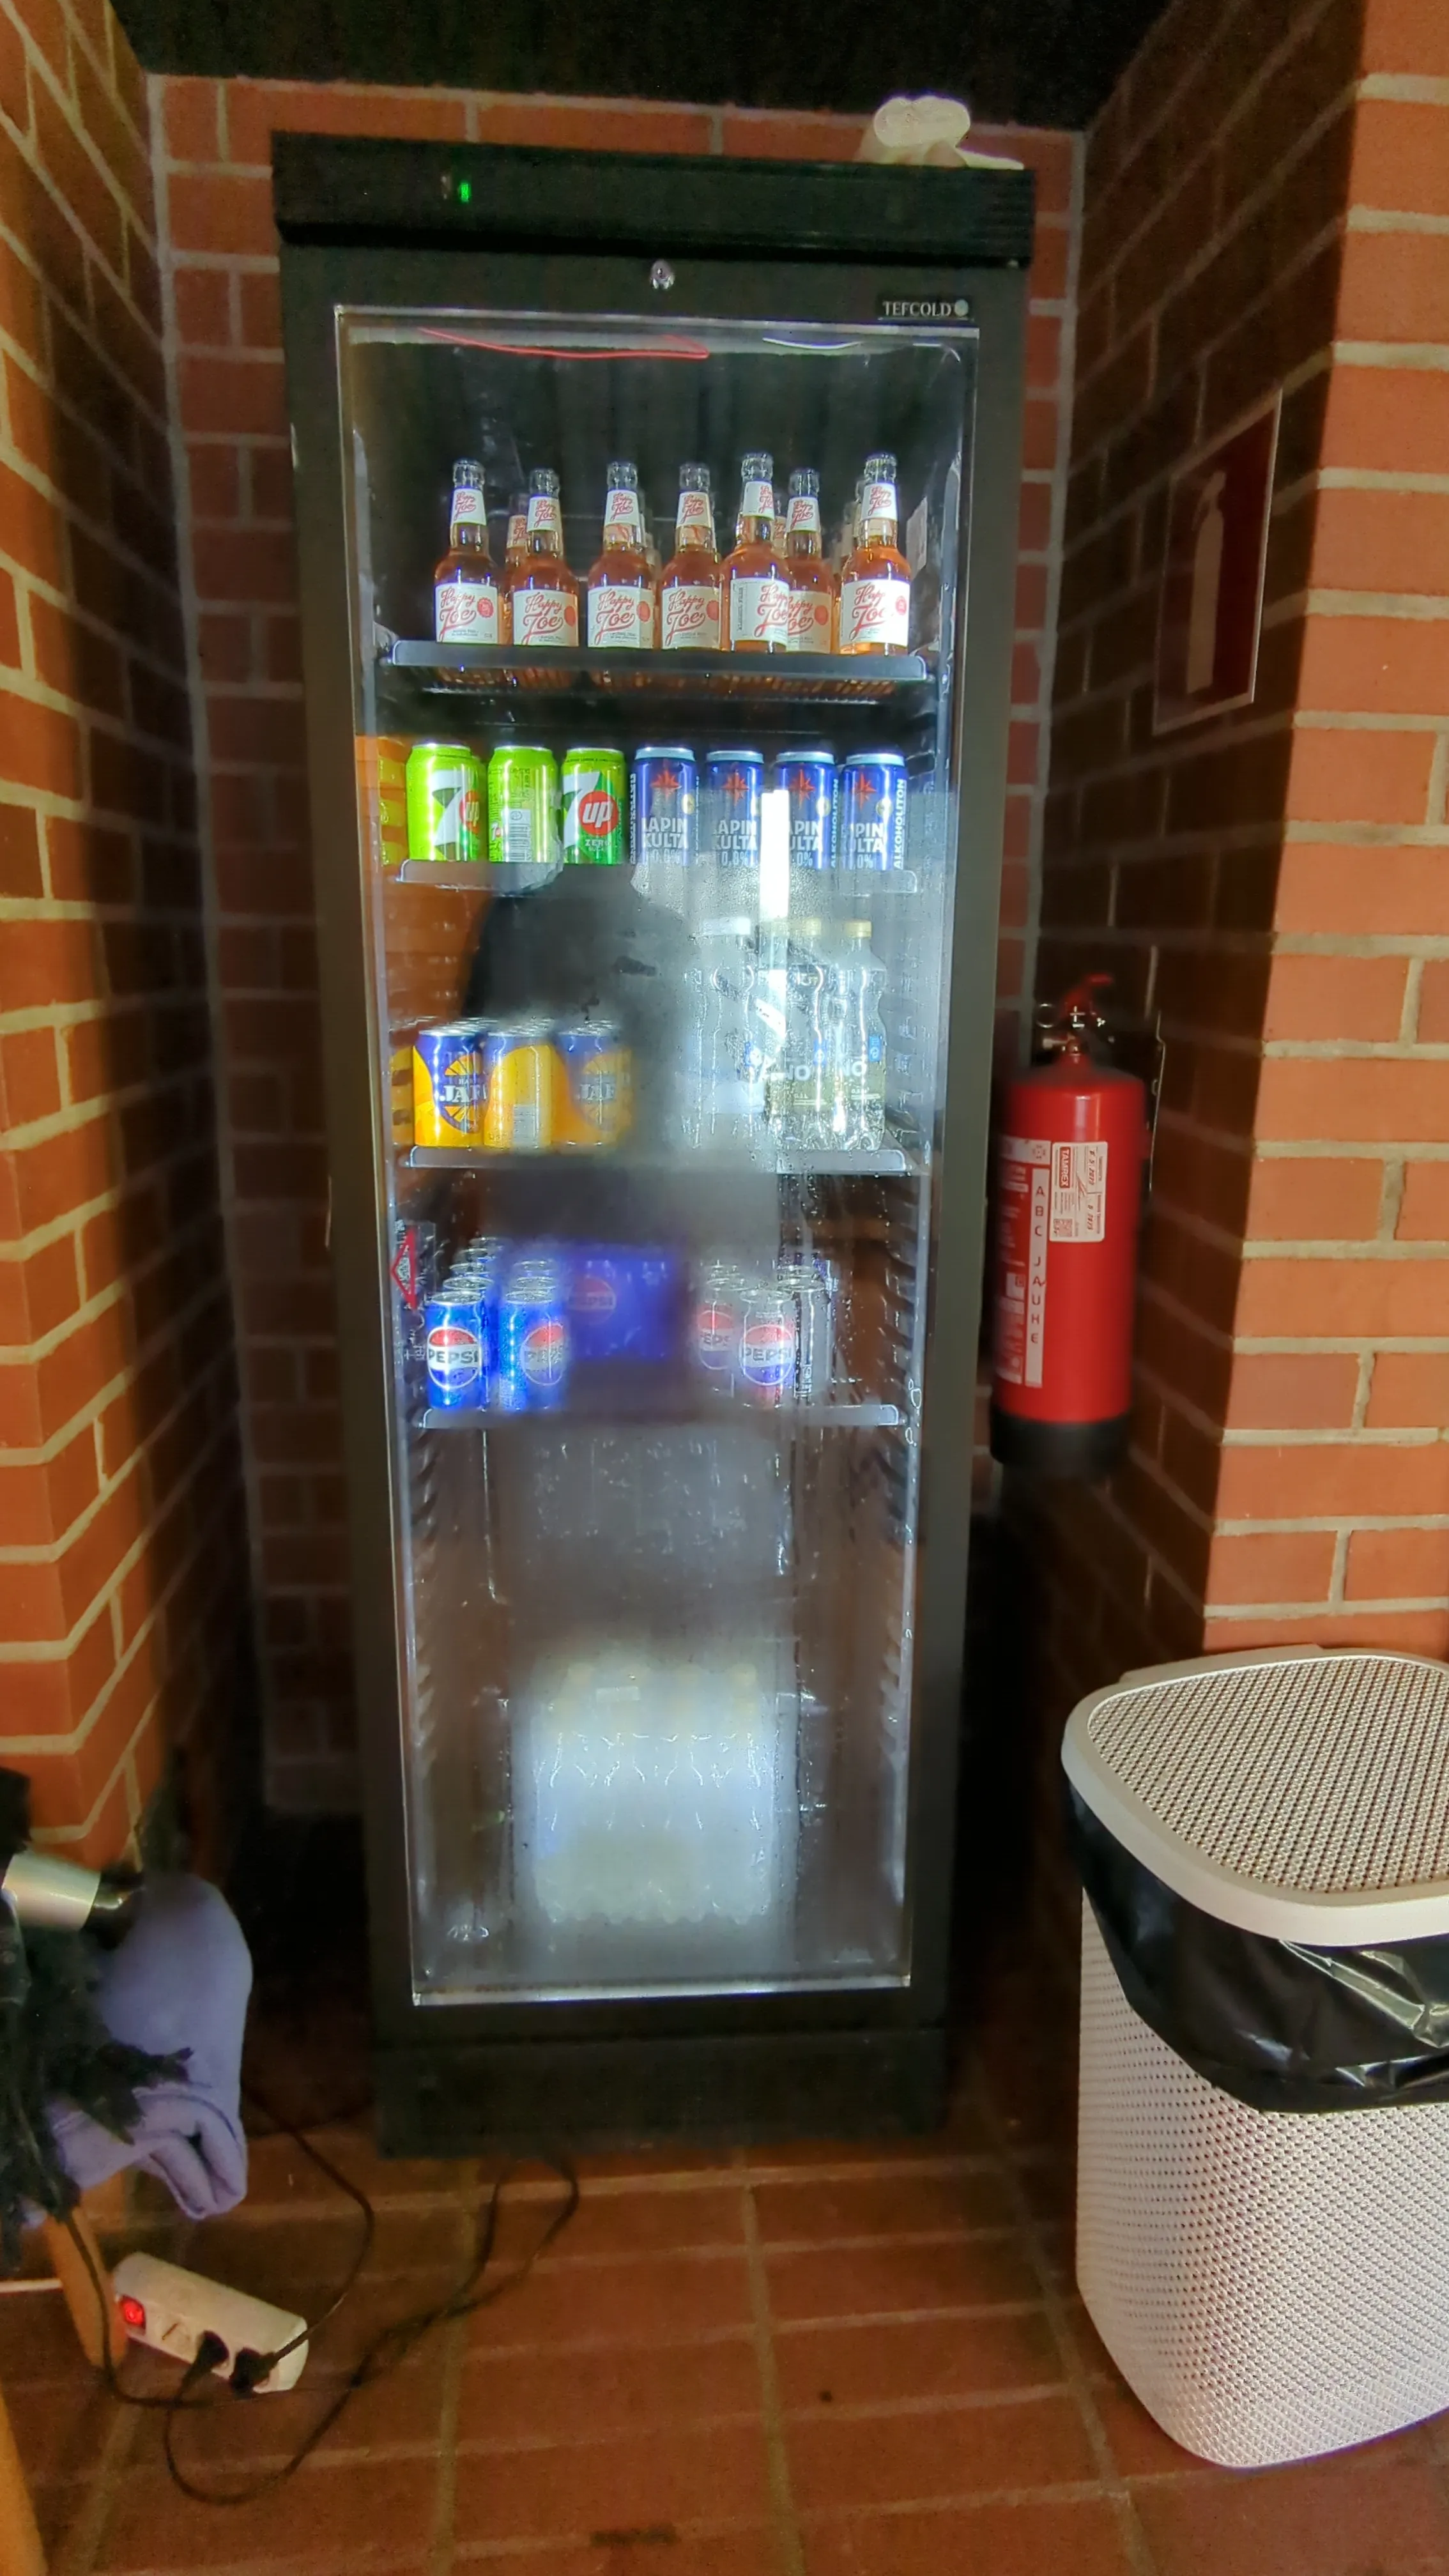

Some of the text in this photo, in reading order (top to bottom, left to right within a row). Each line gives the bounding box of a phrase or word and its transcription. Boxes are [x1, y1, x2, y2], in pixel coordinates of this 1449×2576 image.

[882, 301, 952, 317] TEFCOLD
[441, 586, 475, 608] Happy
[525, 592, 562, 614] Happy
[598, 588, 634, 611] Happy
[668, 588, 705, 613] Happy
[439, 606, 477, 642] Joe
[521, 611, 564, 645] Joe
[594, 608, 636, 646] Joe
[665, 609, 706, 647] Joe
[716, 820, 757, 836] APIN
[831, 778, 839, 868] ALKOHOLITON
[894, 778, 905, 870] ALKOHOLITON
[643, 832, 689, 849] KULTA
[1061, 1149, 1070, 1187] TAMREX
[429, 1348, 479, 1363] PEPSI
[742, 1347, 792, 1361] PEPSI
